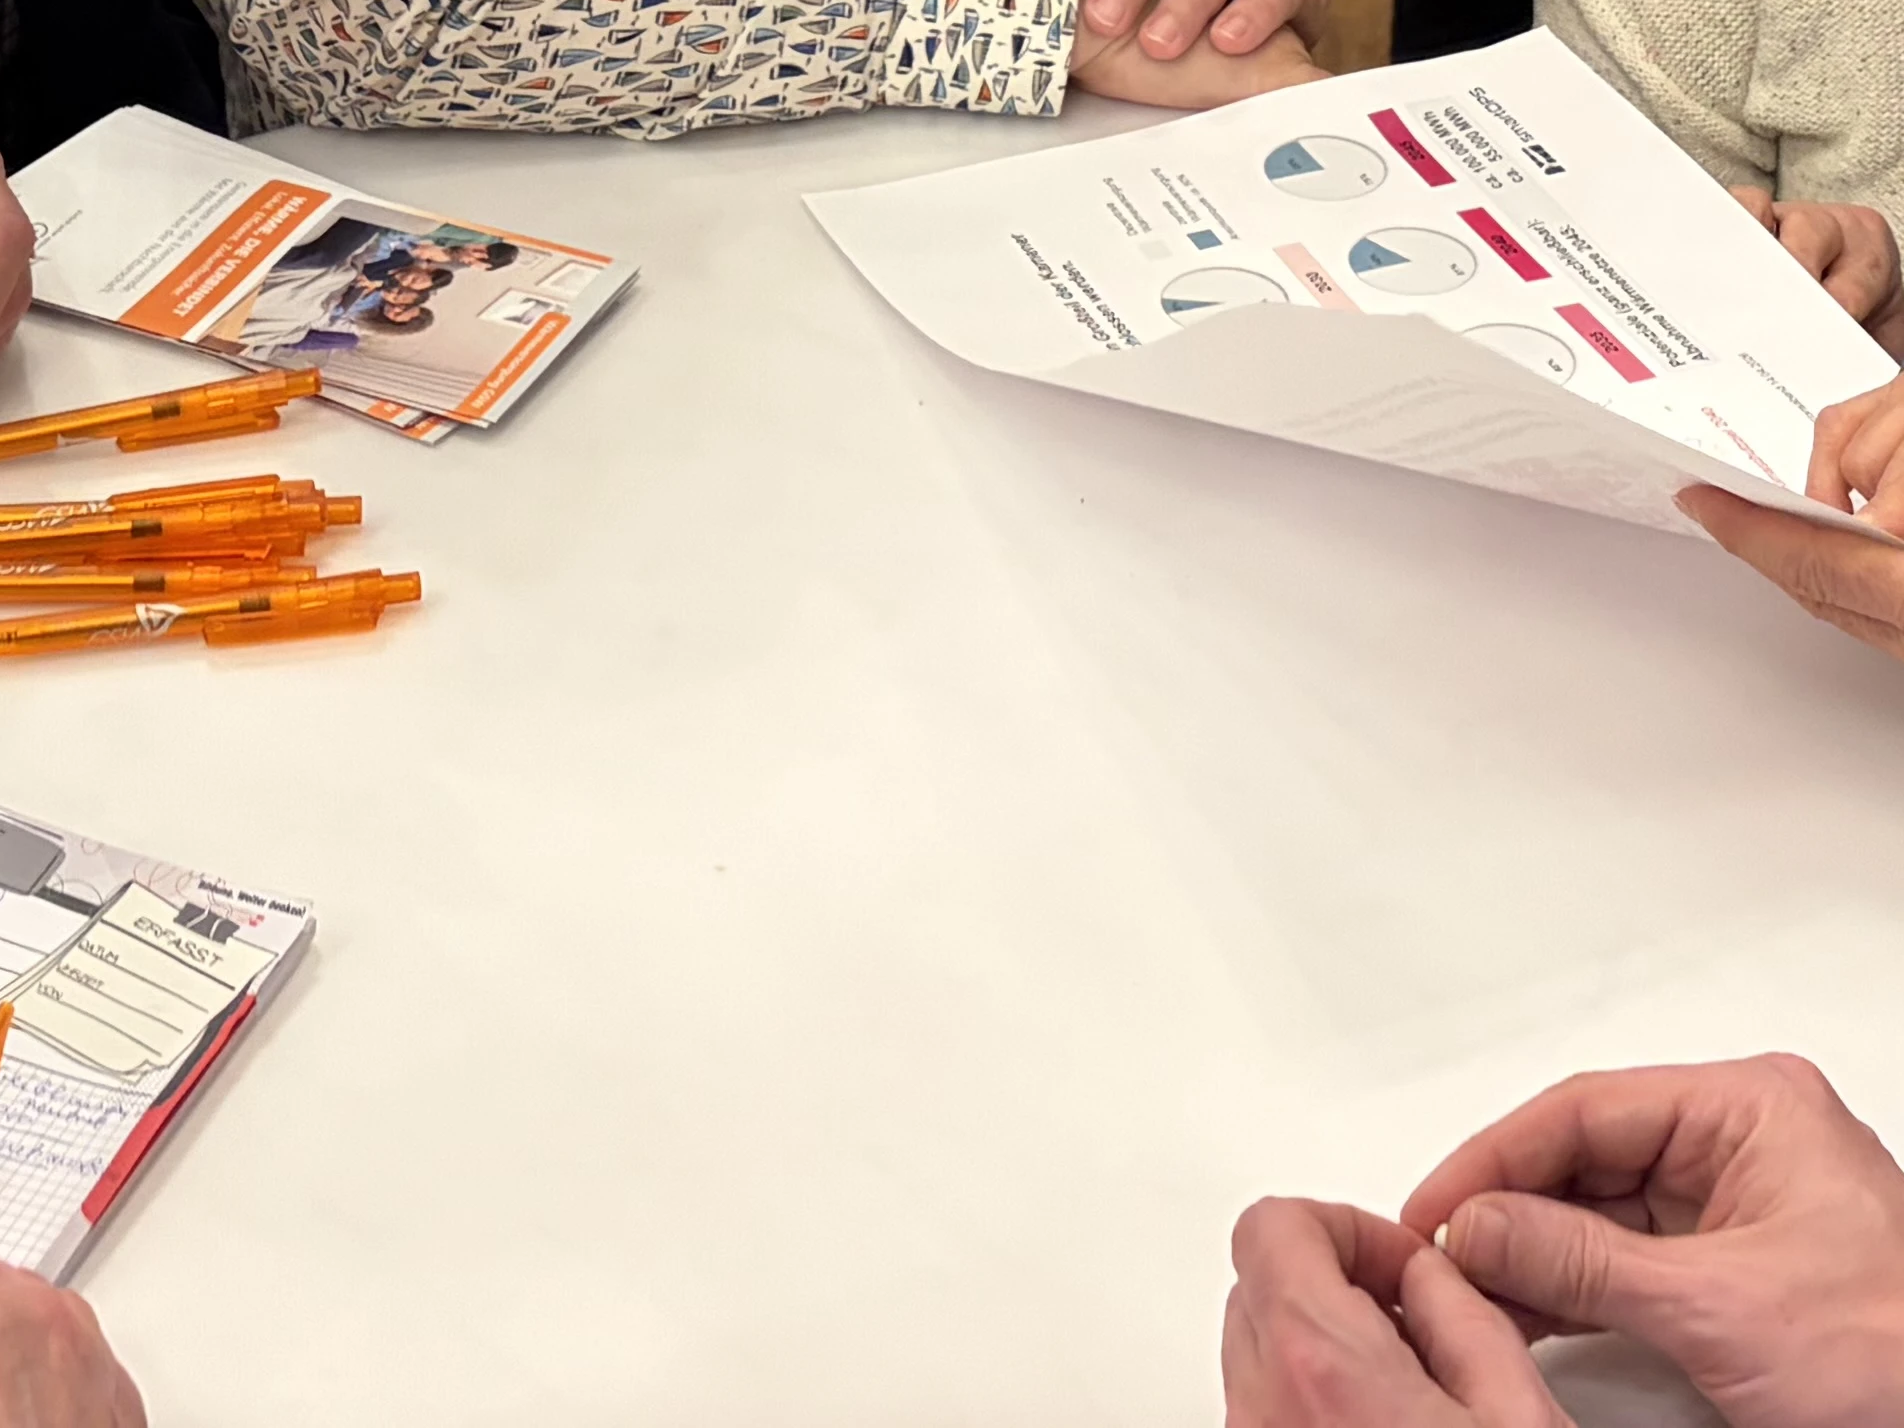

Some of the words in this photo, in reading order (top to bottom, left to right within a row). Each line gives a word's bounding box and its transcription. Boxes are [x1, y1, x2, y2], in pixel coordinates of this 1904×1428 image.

[253, 196, 306, 235] WÄRME,
[234, 237, 261, 258] DIE
[173, 259, 240, 316] VERBINDET
[1589, 253, 1654, 314] Wärmenetze
[1626, 315, 1685, 368] Potenziale
[1652, 315, 1709, 361] Abnahme
[133, 917, 222, 966] ERFASST
